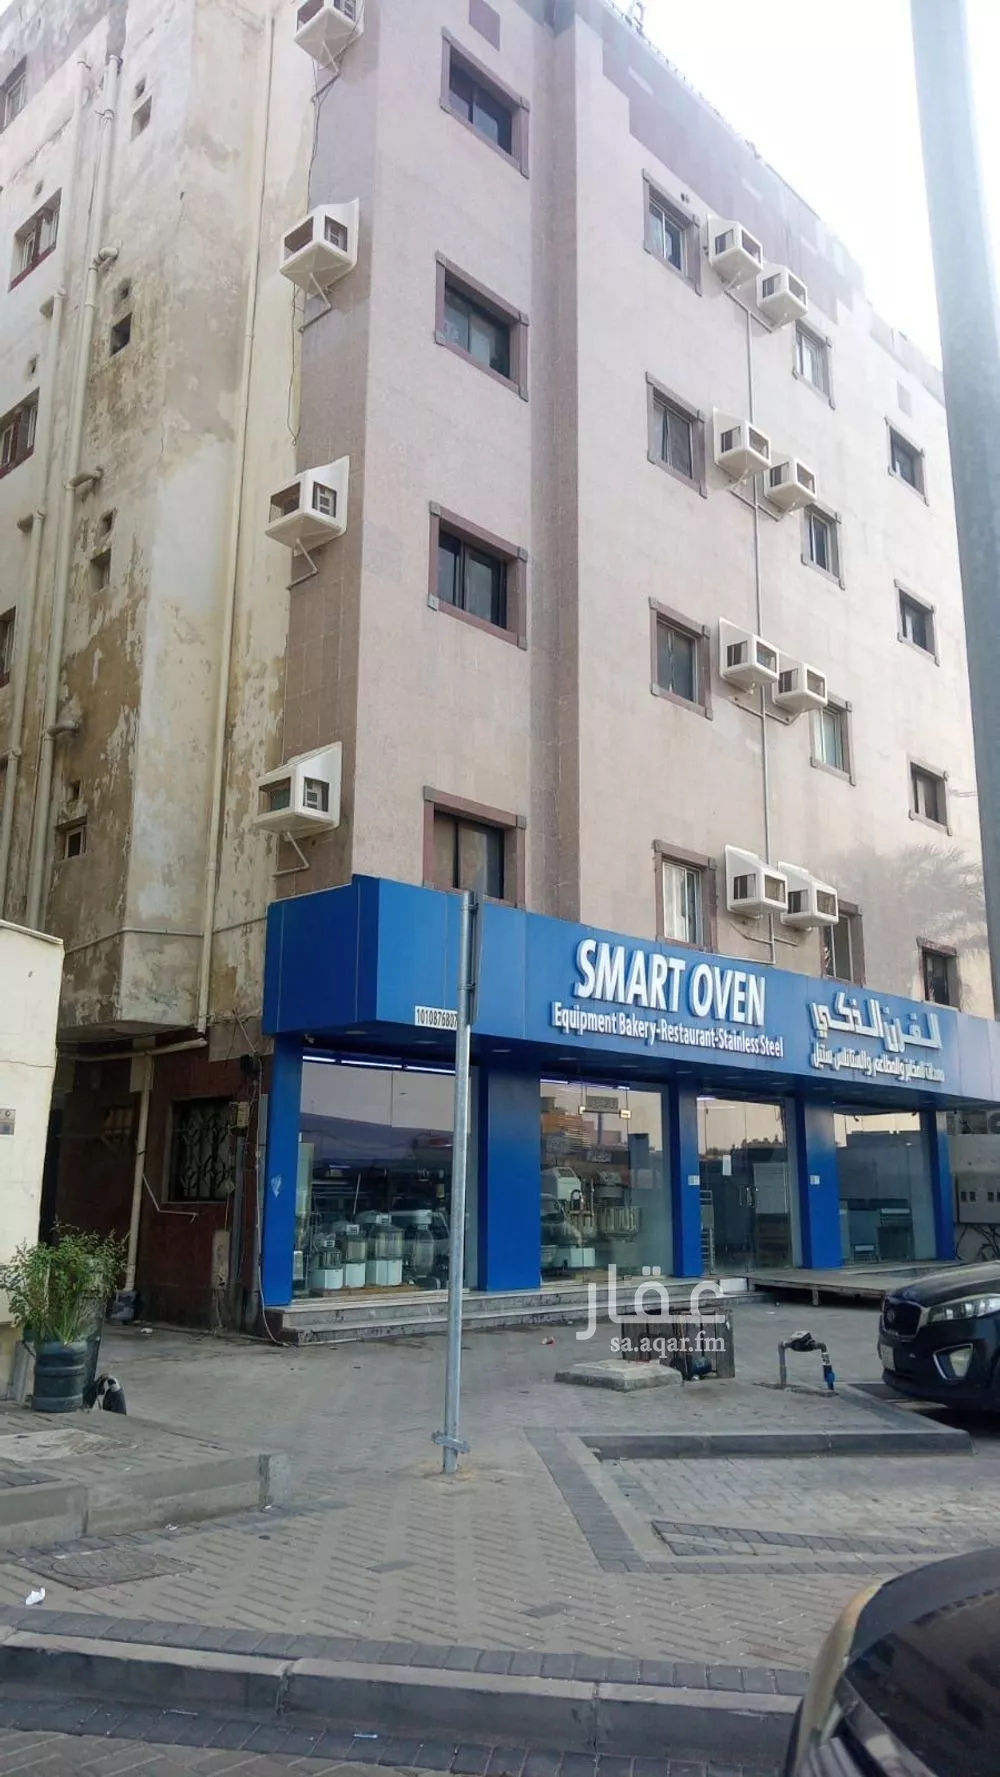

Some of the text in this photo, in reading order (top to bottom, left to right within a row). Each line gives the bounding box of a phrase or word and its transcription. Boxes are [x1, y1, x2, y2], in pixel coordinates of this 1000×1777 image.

[573, 938, 766, 1027] SMART OVEN
[552, 1001, 618, 1036] Equipment
[759, 1034, 785, 1058] Steel
[809, 991, 884, 1038] الذكي
